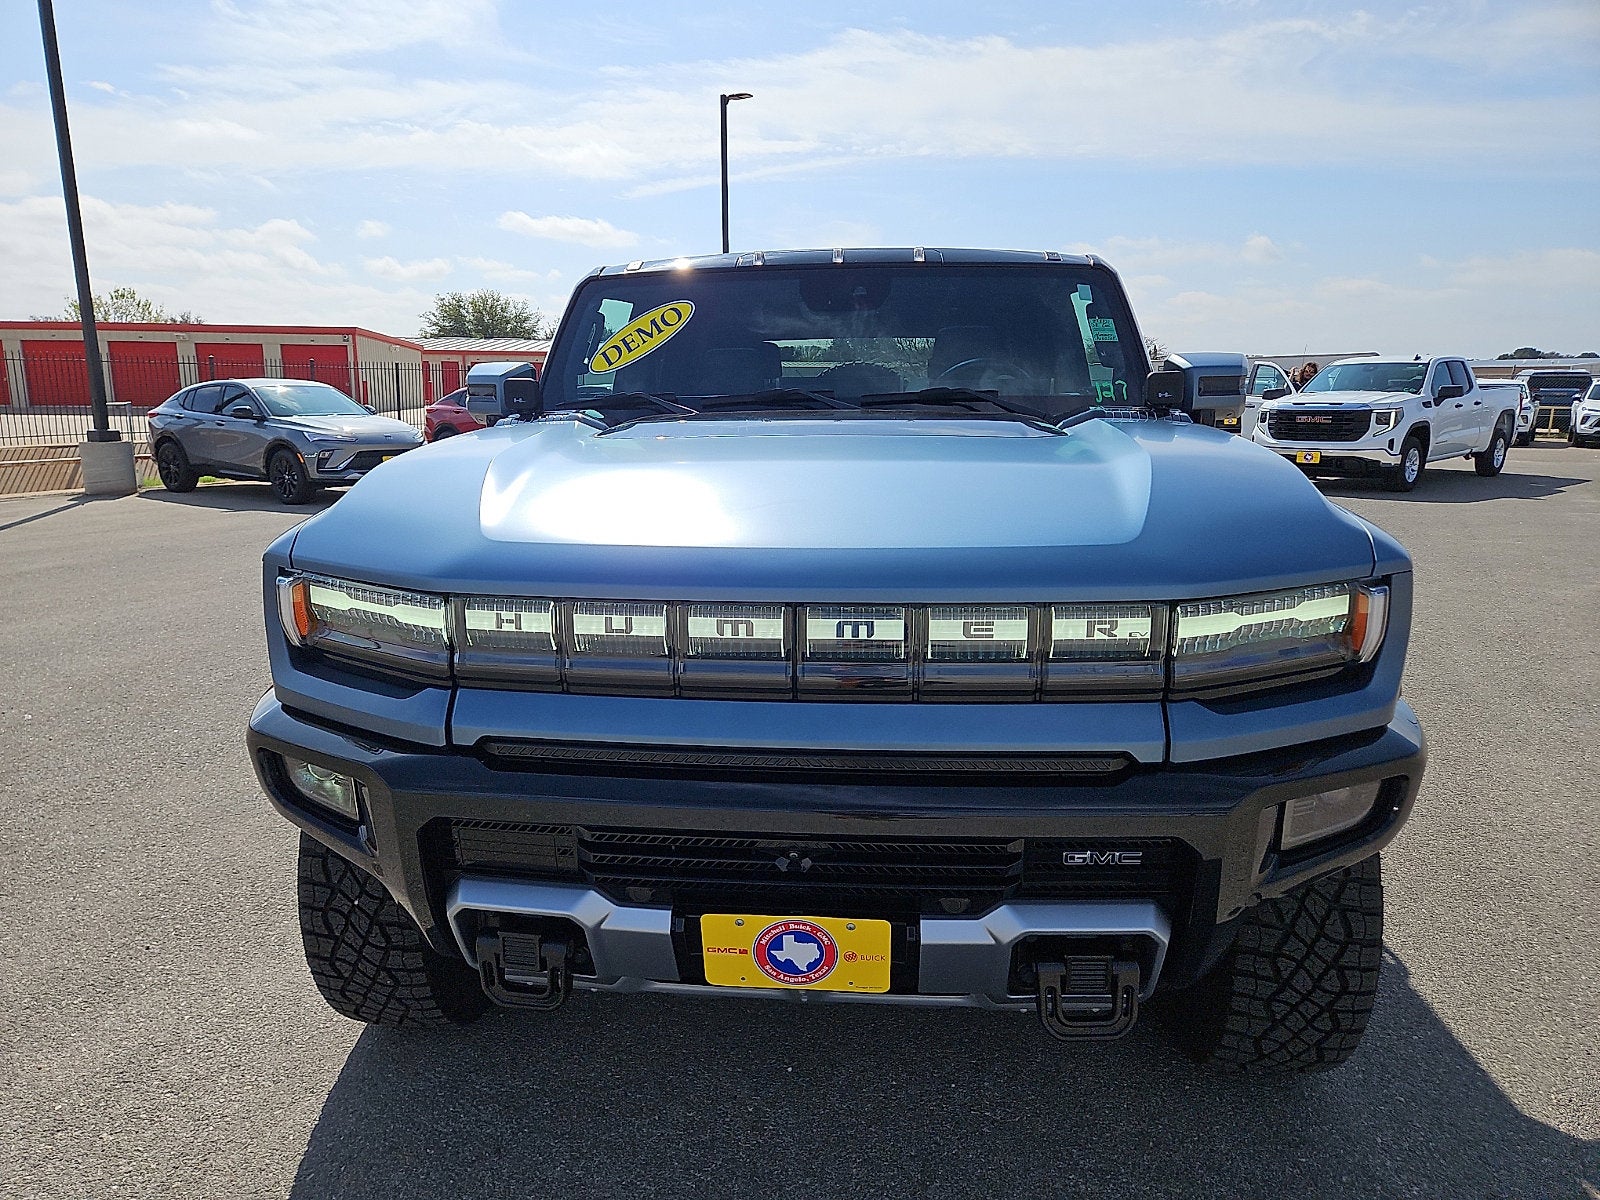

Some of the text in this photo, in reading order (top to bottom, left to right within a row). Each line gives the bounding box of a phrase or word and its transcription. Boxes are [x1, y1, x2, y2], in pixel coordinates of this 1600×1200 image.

[599, 307, 682, 367] DEMO
[1063, 851, 1142, 865] GMC
[760, 925, 786, 946] Mitchell
[788, 923, 812, 932] Buick
[817, 931, 831, 946] GMC
[706, 947, 738, 955] GMC
[860, 954, 886, 962] BUICK
[764, 964, 777, 976] San
[809, 965, 829, 980] Texas
